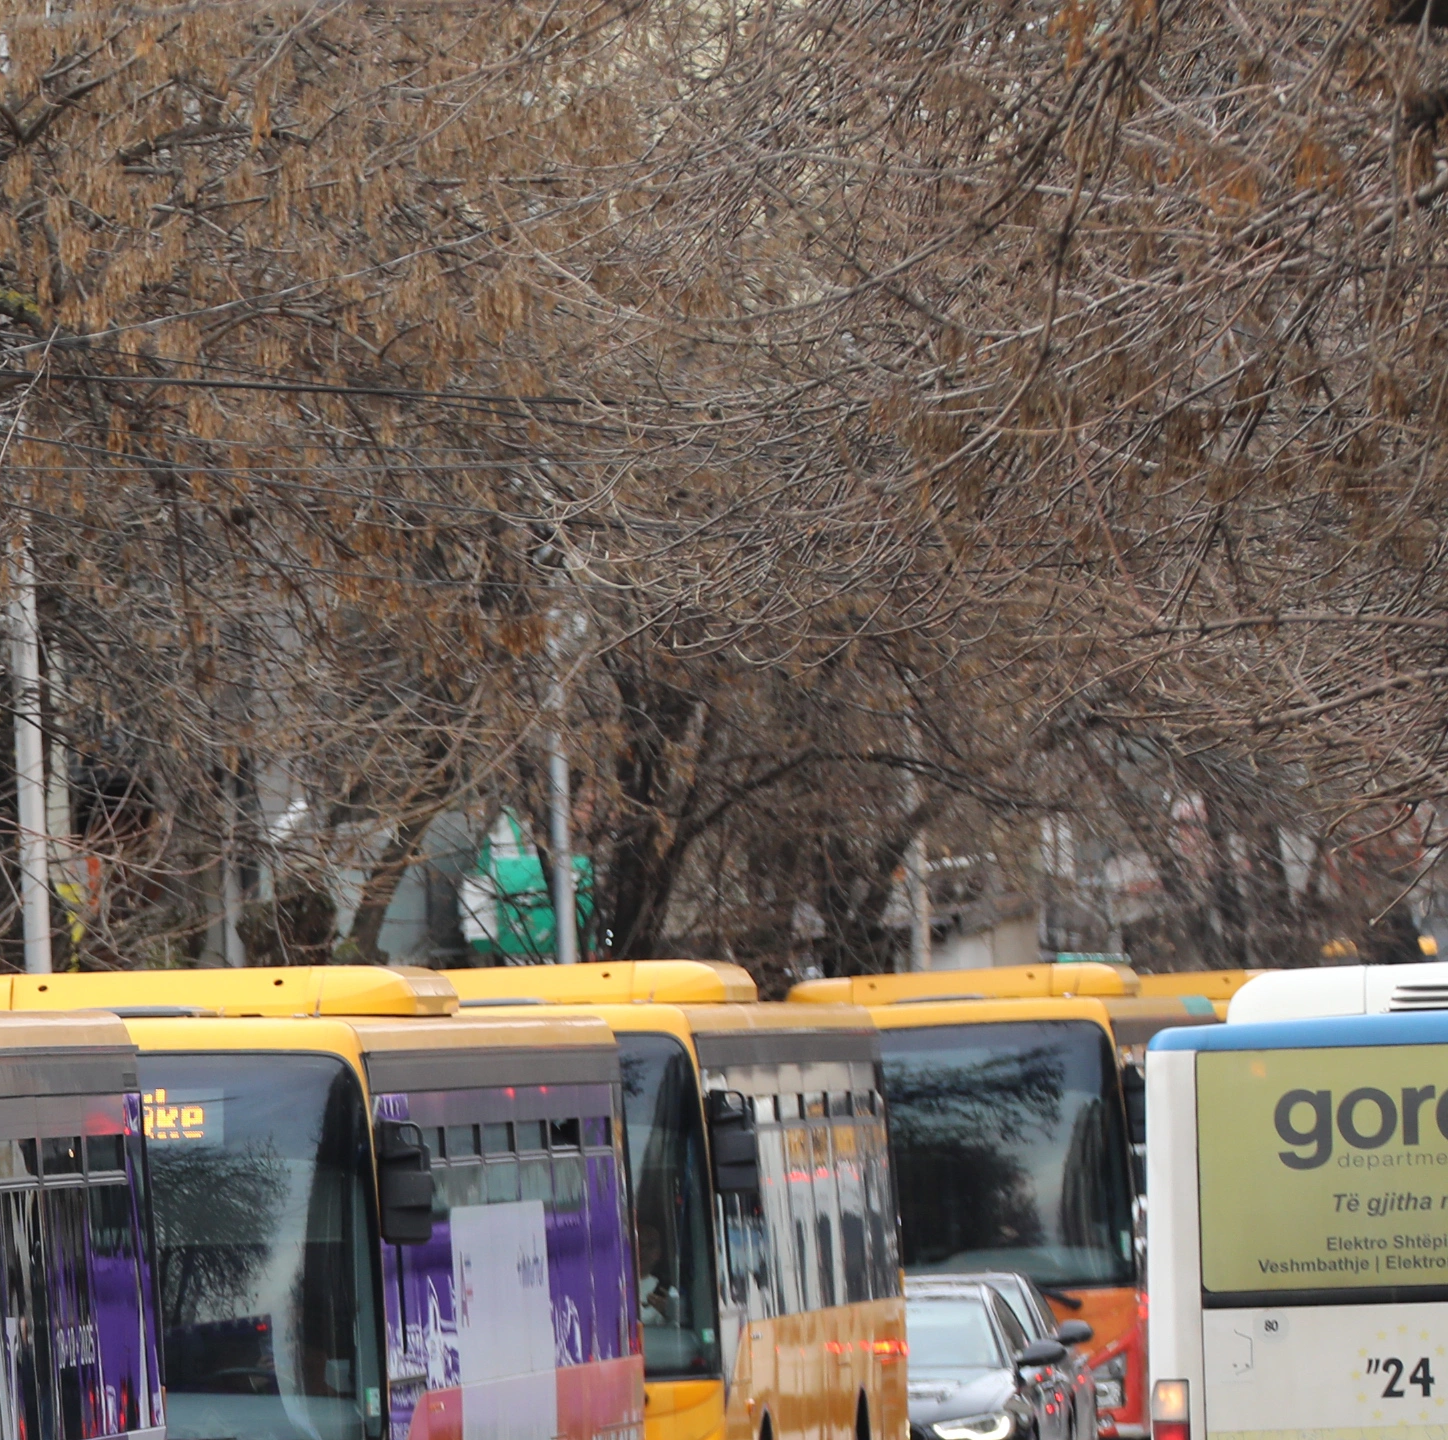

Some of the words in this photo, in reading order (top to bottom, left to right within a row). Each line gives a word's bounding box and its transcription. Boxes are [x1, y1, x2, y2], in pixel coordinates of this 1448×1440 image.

[1274, 1085, 1448, 1170] gor
[1333, 1193, 1360, 1213] Të
[1367, 1191, 1432, 1217] gjitha
[1326, 1236, 1388, 1251] Elektro
[1258, 1257, 1370, 1275] Veshmbathje
[1385, 1255, 1448, 1271] Elektro
[1264, 1319, 1279, 1332] 80
